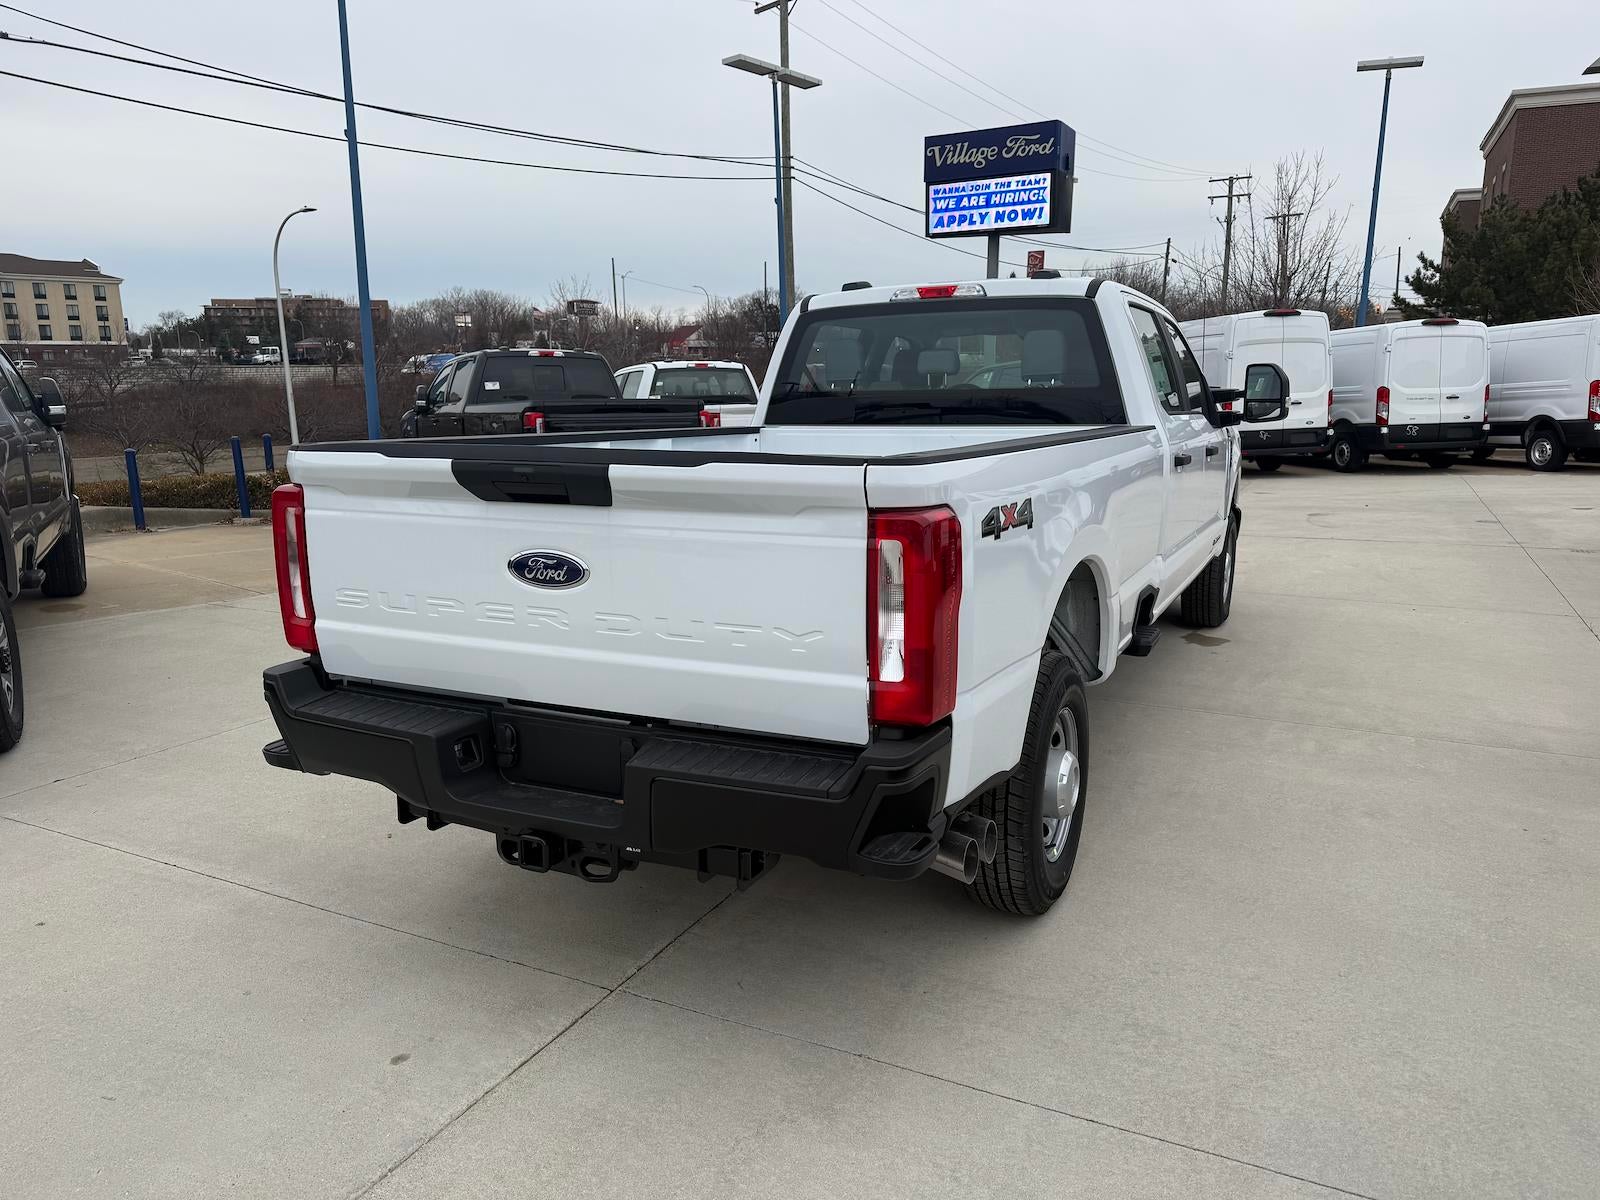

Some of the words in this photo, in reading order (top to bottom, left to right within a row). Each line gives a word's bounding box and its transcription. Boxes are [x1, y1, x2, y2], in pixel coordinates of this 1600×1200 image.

[927, 142, 998, 168] Village
[1002, 134, 1055, 158] Ford
[933, 186, 966, 196] WANNA
[970, 183, 991, 192] JOIN
[995, 182, 1012, 190] THE
[1016, 178, 1047, 187] TEAM?
[936, 198, 957, 209] WE
[960, 195, 987, 207] ARE
[990, 189, 1044, 205] HIRING!
[934, 211, 989, 228] APPLY
[994, 207, 1044, 224] NOW!
[1405, 425, 1420, 436] 58
[524, 557, 569, 581] Ford
[336, 587, 570, 630] SUPER
[595, 611, 824, 652] DUTY
